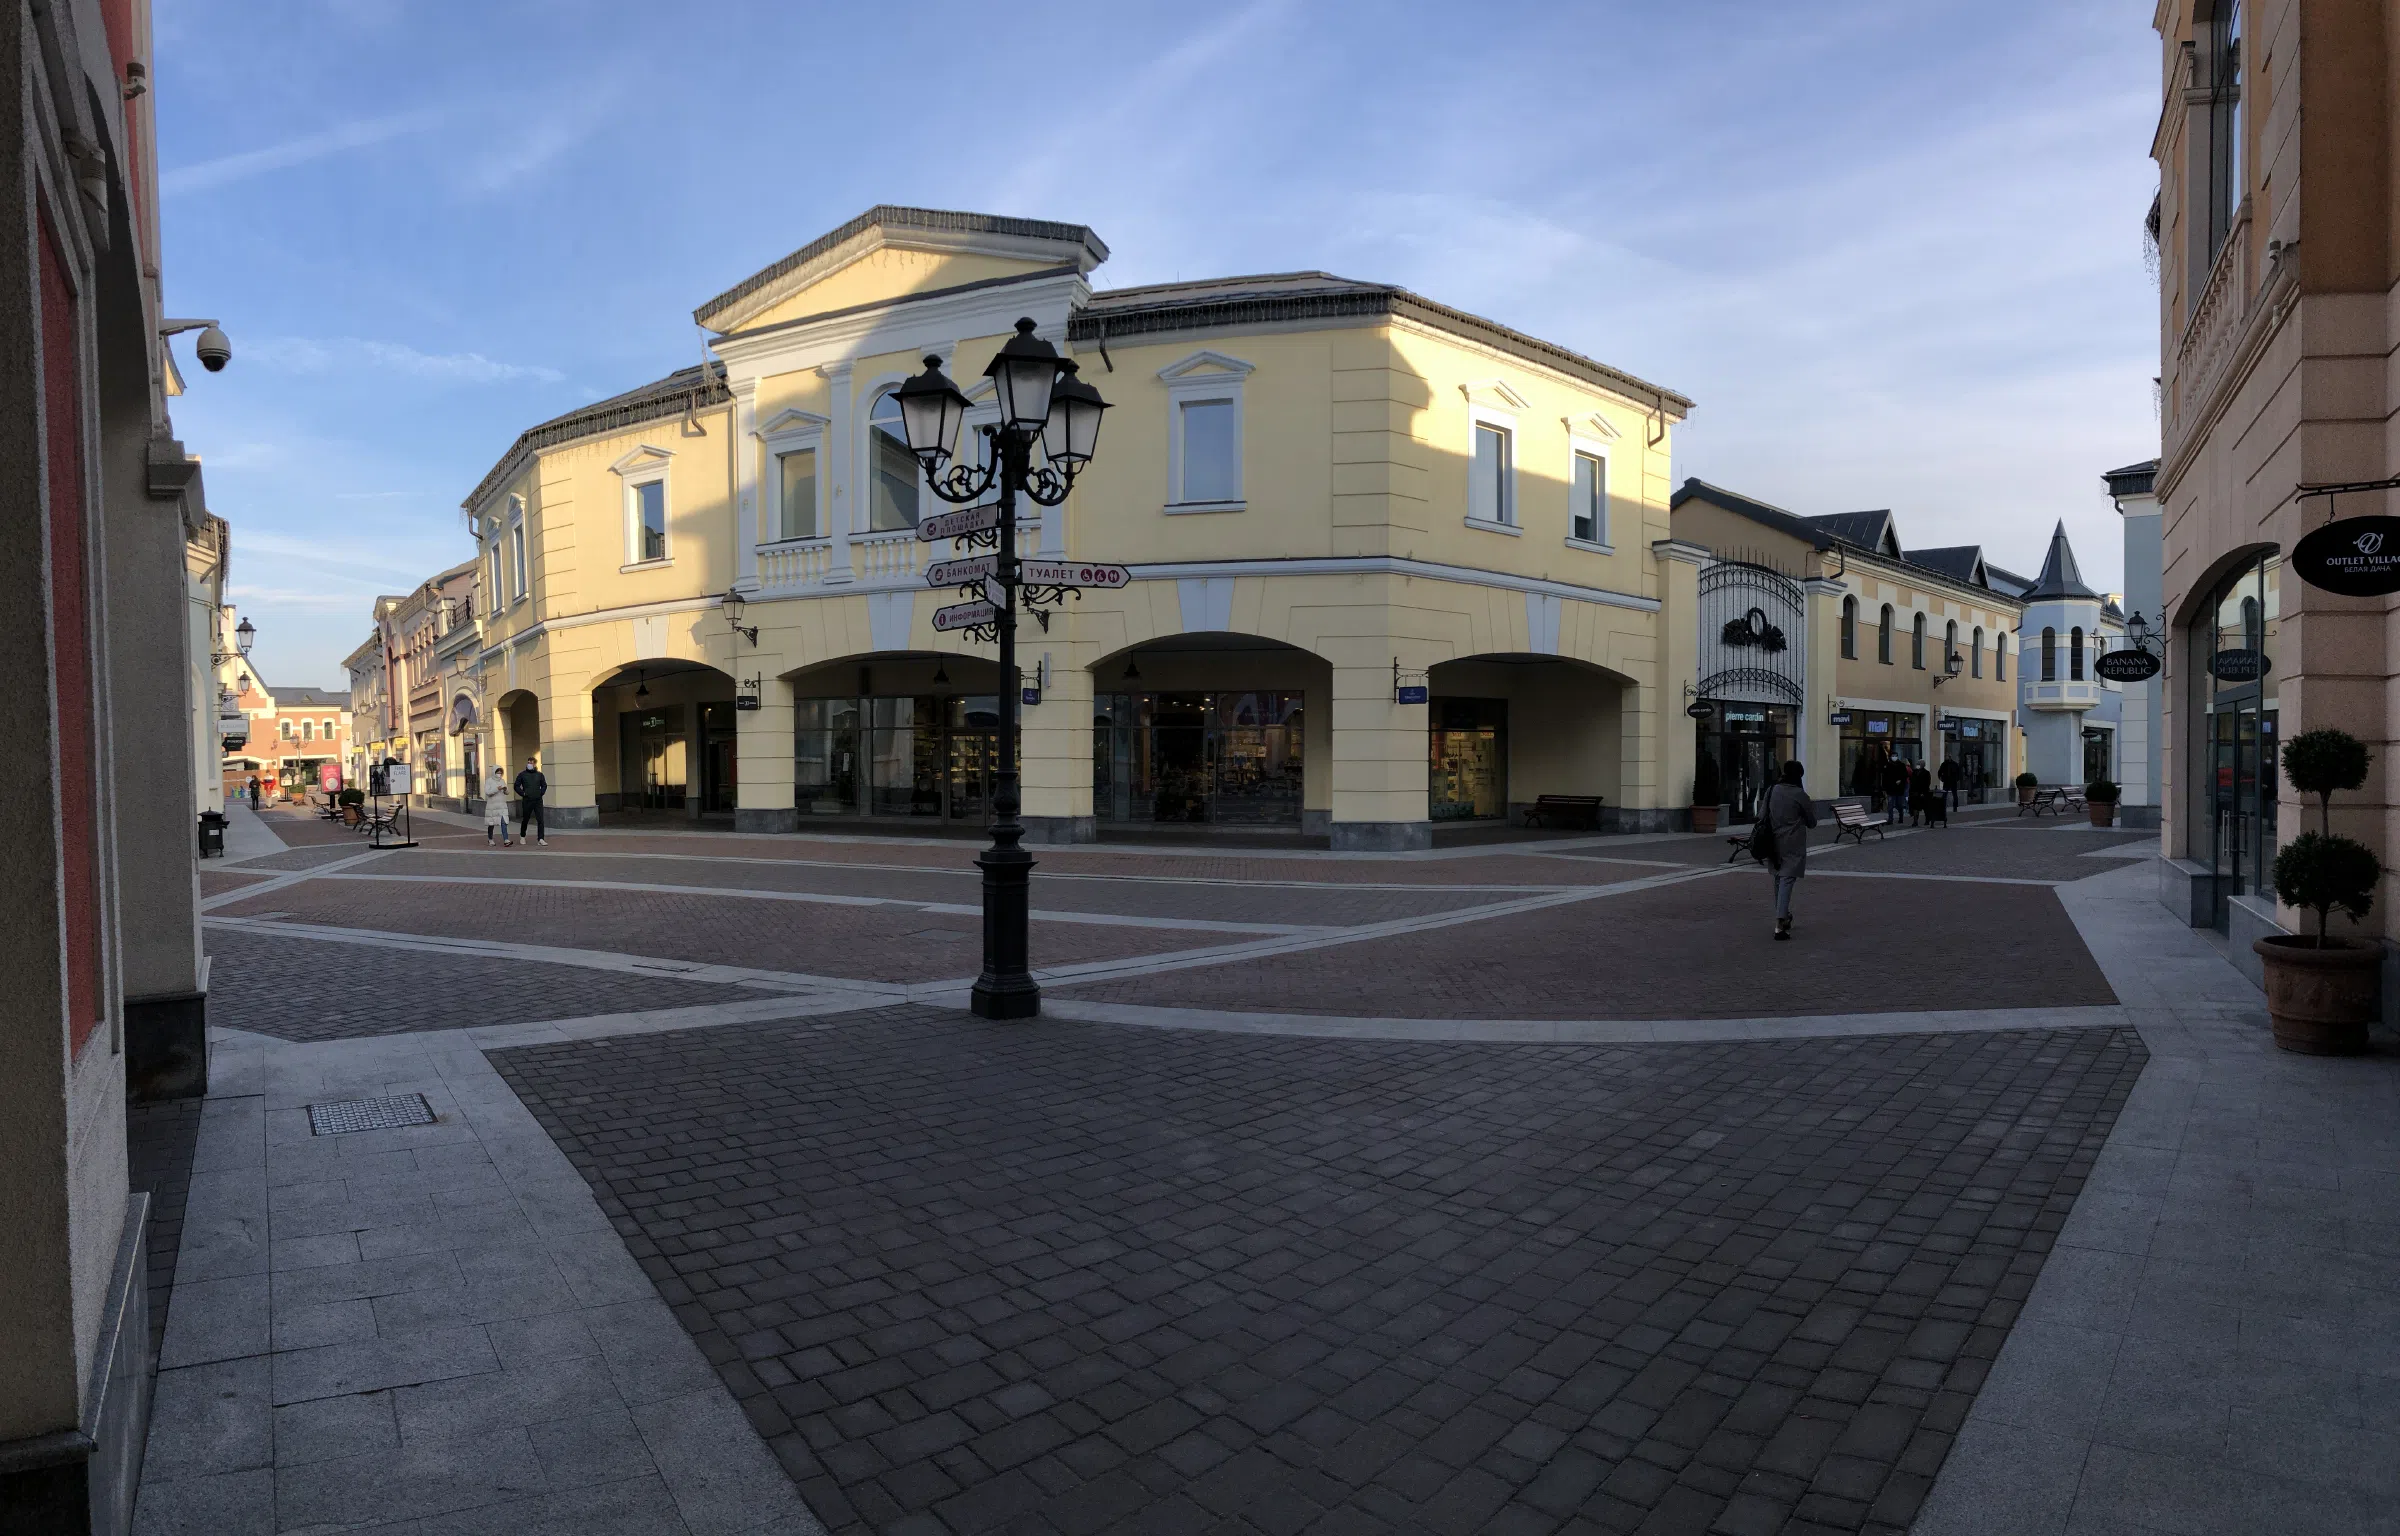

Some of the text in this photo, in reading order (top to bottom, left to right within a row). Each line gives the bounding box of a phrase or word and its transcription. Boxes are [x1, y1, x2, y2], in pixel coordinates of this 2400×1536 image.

[945, 512, 980, 527] ДЕТСКАЯ
[940, 519, 984, 534] ПЛОЩАДКА
[2326, 556, 2365, 566] OUTLET
[946, 563, 991, 578] БАНКОМАТ
[1029, 567, 1075, 579] ТУАЛЕТ
[2370, 565, 2392, 573] ДАЧА
[949, 607, 994, 623] ИНФОРМАЦИЯ
[2106, 657, 2148, 666] BANANA
[2103, 666, 2152, 675] REPUBLIC
[1725, 711, 1764, 722] pierre cardin
[1833, 715, 1850, 723] mavi
[1868, 718, 1888, 733] mavi
